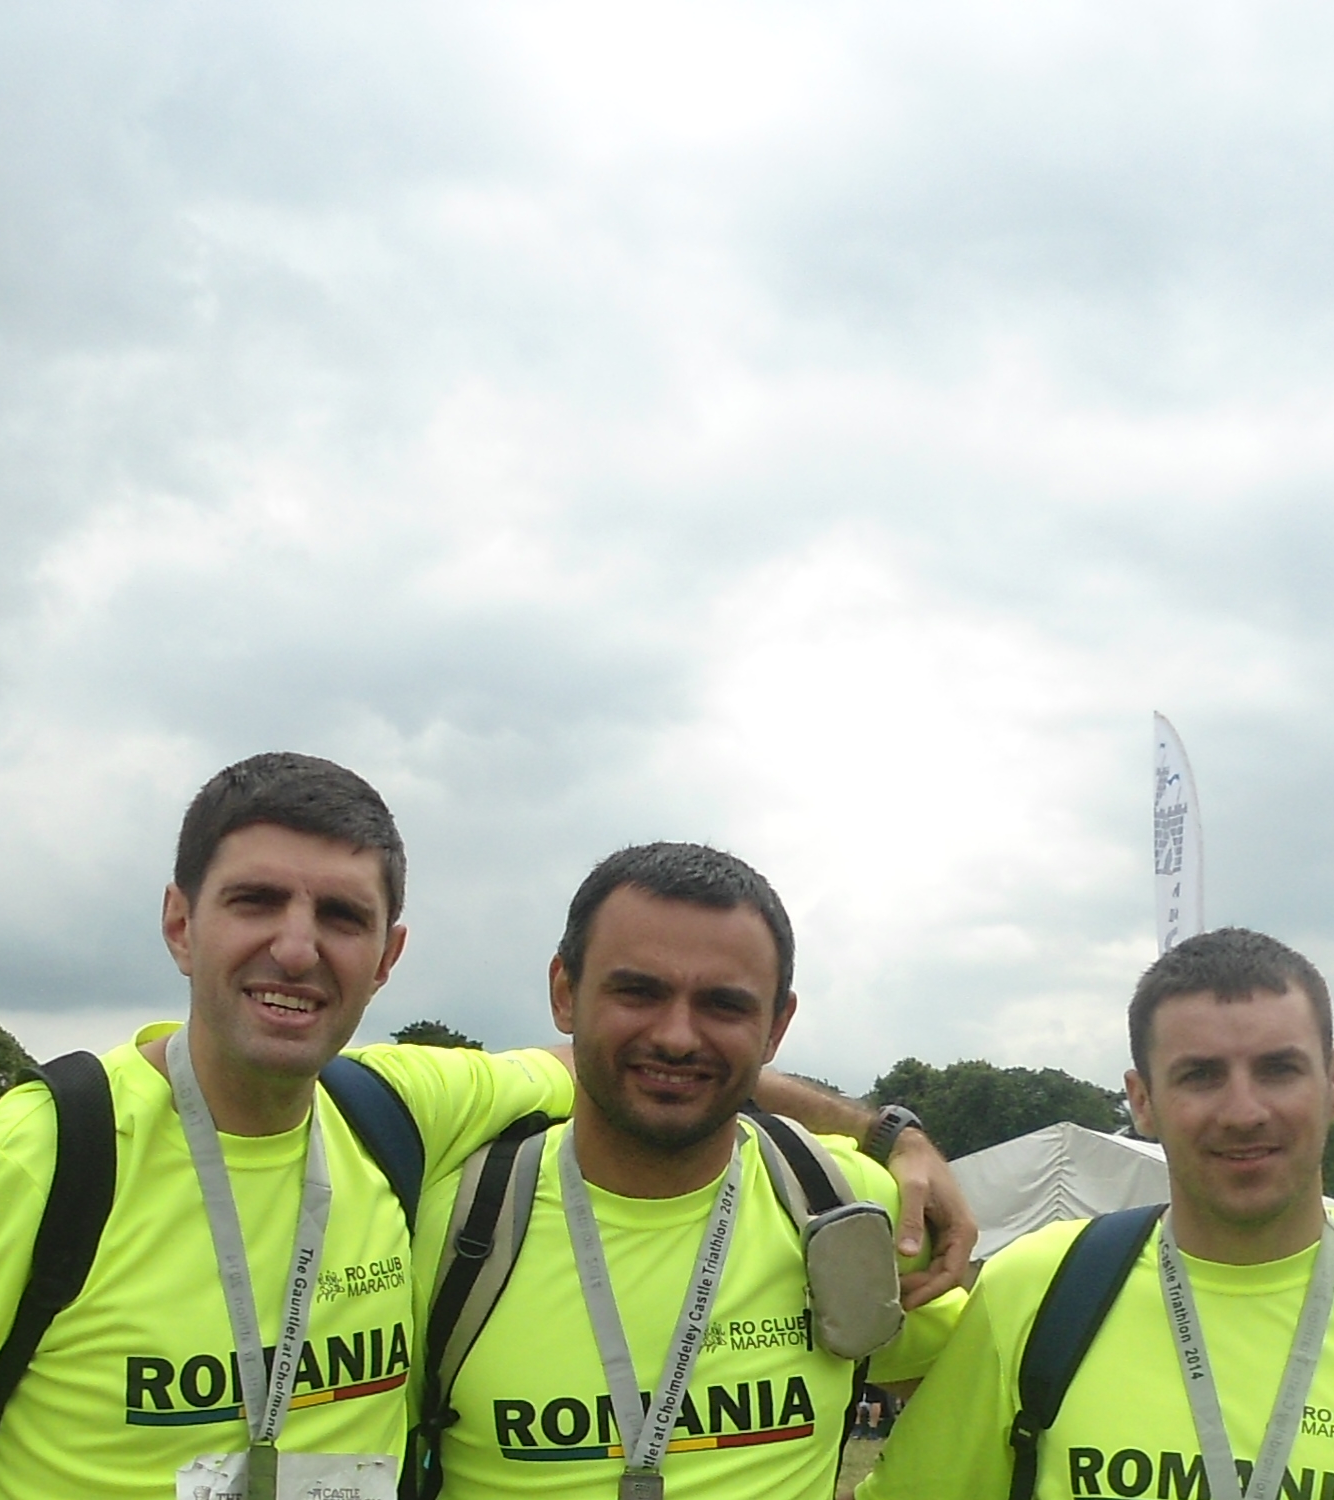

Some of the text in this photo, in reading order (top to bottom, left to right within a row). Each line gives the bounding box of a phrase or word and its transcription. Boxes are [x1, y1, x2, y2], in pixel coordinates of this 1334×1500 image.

[719, 1182, 738, 1215] 2014
[701, 1217, 729, 1277] Triathlon
[345, 1256, 403, 1282] RO CLUB
[346, 1273, 406, 1299] MARATON
[688, 1277, 715, 1323] Castle
[729, 1316, 806, 1336] RO CLUB
[1167, 1281, 1192, 1343] Triathlon
[1184, 1347, 1205, 1381] 2014
[265, 1248, 314, 1438] The Gauntlet at Cholmond
[655, 1326, 704, 1424] Cholmondeley
[1303, 1405, 1332, 1422] RO
[322, 1488, 360, 1499] CASTLE
